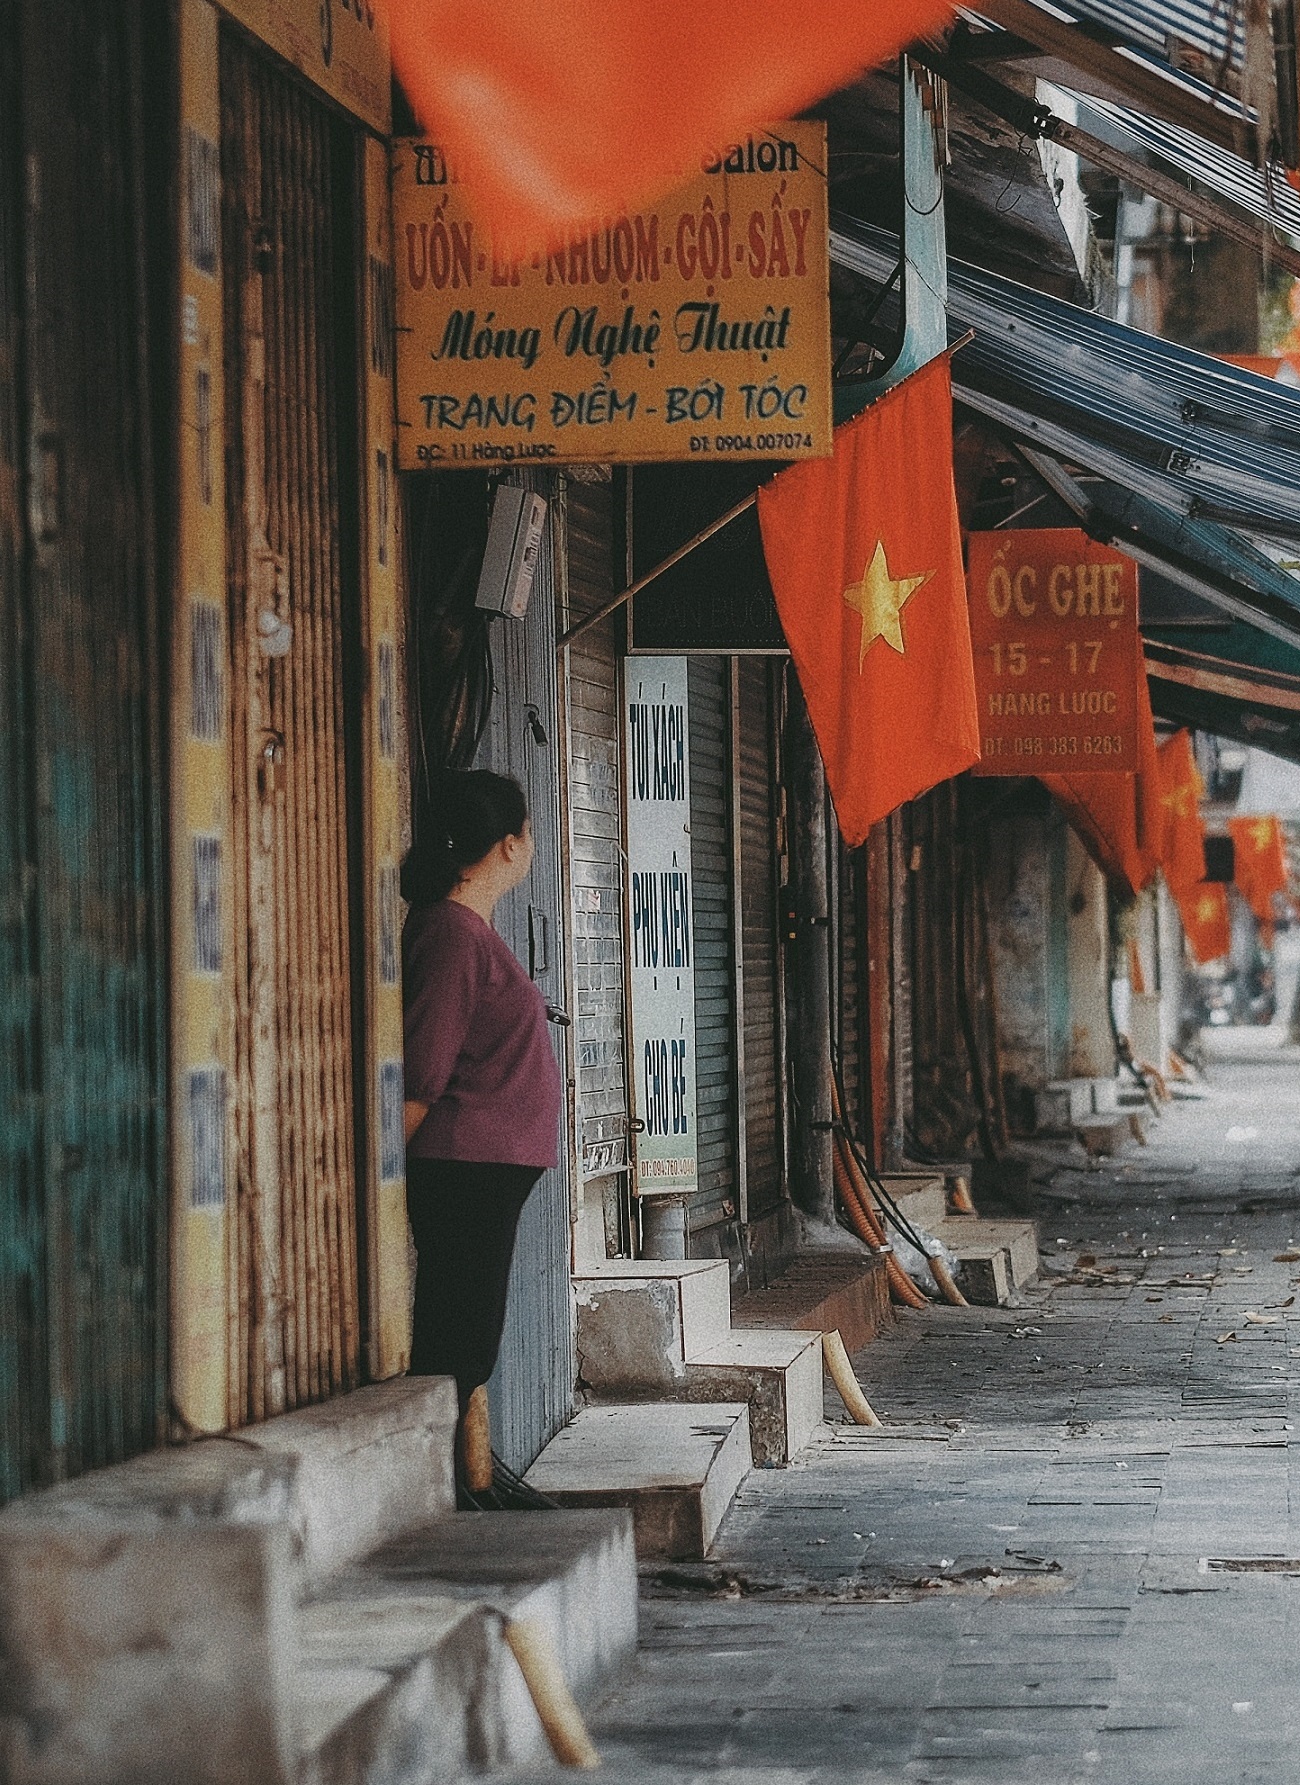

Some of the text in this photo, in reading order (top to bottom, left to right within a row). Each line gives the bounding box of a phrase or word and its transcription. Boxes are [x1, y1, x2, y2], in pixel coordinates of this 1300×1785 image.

[405, 192, 473, 291] UỐN
[749, 179, 812, 278] SẤY
[430, 301, 791, 370] Móng Nghệ Thuật
[420, 392, 537, 433] TRANG
[550, 371, 638, 428] ĐIỂM
[452, 443, 466, 460] 11
[986, 540, 1126, 630] ỐC GHẸ
[988, 642, 1028, 676] 15
[1064, 641, 1103, 675] 17
[630, 681, 685, 802] TÚI XÁCH
[633, 850, 690, 991] PHỤ KIỆN
[644, 1017, 688, 1137] CHO BÉ
